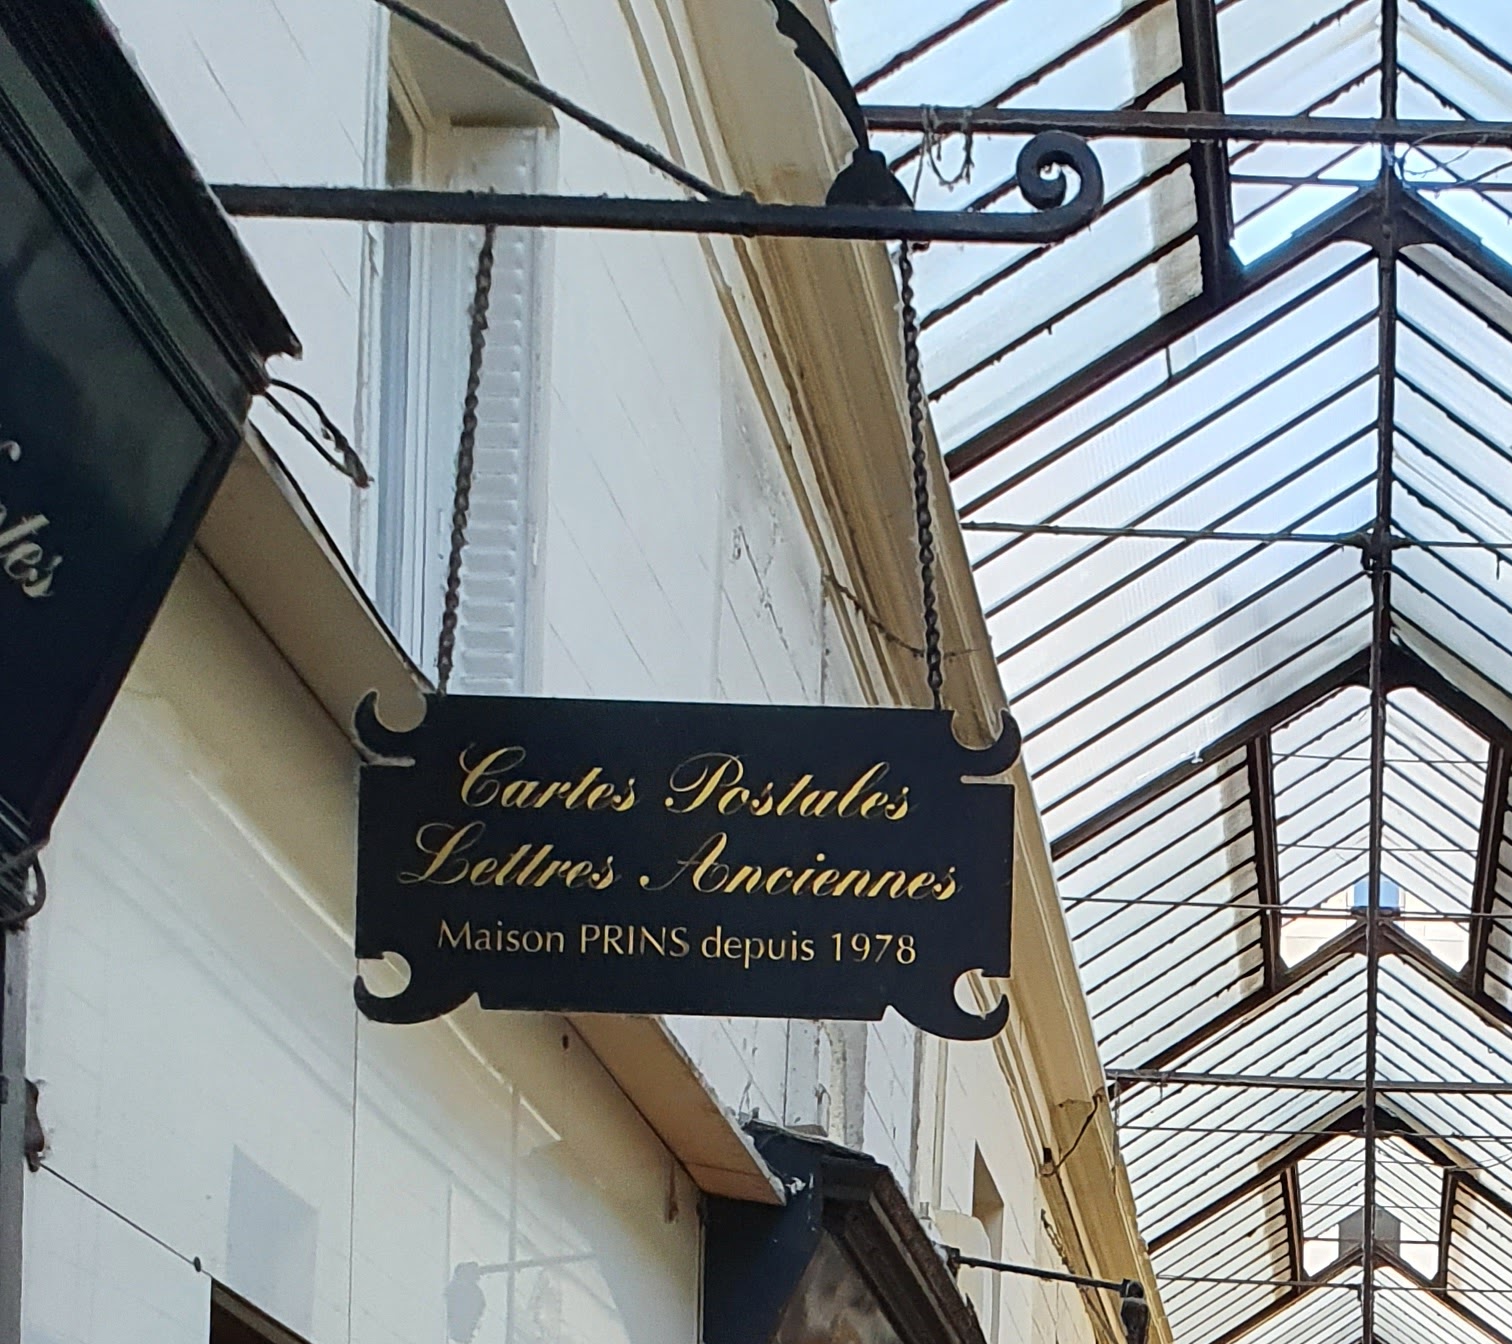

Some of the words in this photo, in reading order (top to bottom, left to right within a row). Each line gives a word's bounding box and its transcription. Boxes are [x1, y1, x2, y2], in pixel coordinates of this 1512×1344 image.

[458, 742, 638, 812] Cartes
[664, 752, 916, 822] Postales
[397, 821, 620, 891] Lettres
[640, 831, 963, 902] Anciennes
[438, 919, 565, 955] Maison
[580, 924, 690, 958] PRINS
[701, 924, 815, 968] depuis
[830, 933, 917, 965] 1978
